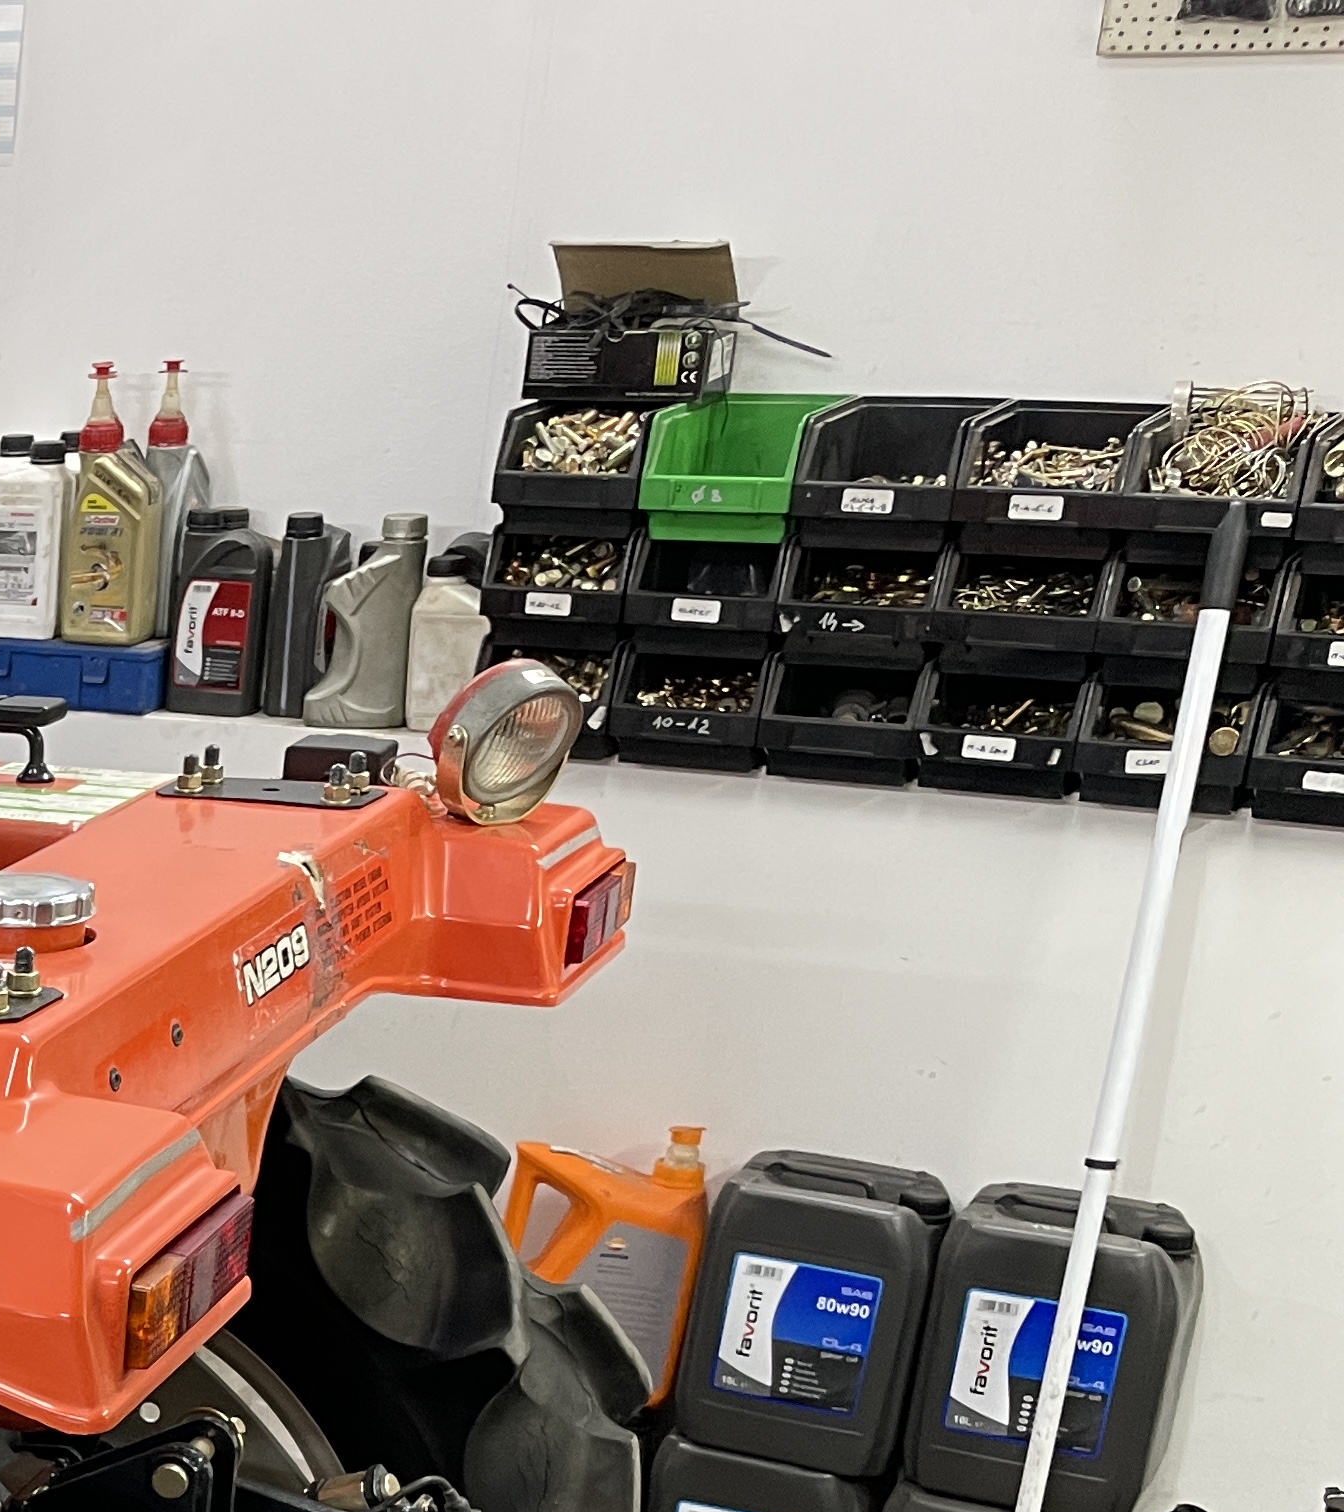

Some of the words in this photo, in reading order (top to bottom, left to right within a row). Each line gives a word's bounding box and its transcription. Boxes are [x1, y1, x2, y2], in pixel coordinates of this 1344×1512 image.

[212, 607, 230, 617] ATF
[184, 606, 198, 655] favorit
[652, 715, 711, 735] 10-12
[242, 922, 310, 1007] N209
[735, 1287, 764, 1358] favorit
[816, 1296, 870, 1320] 80w90
[969, 1324, 999, 1396] favorit
[1076, 1339, 1113, 1356] w90
